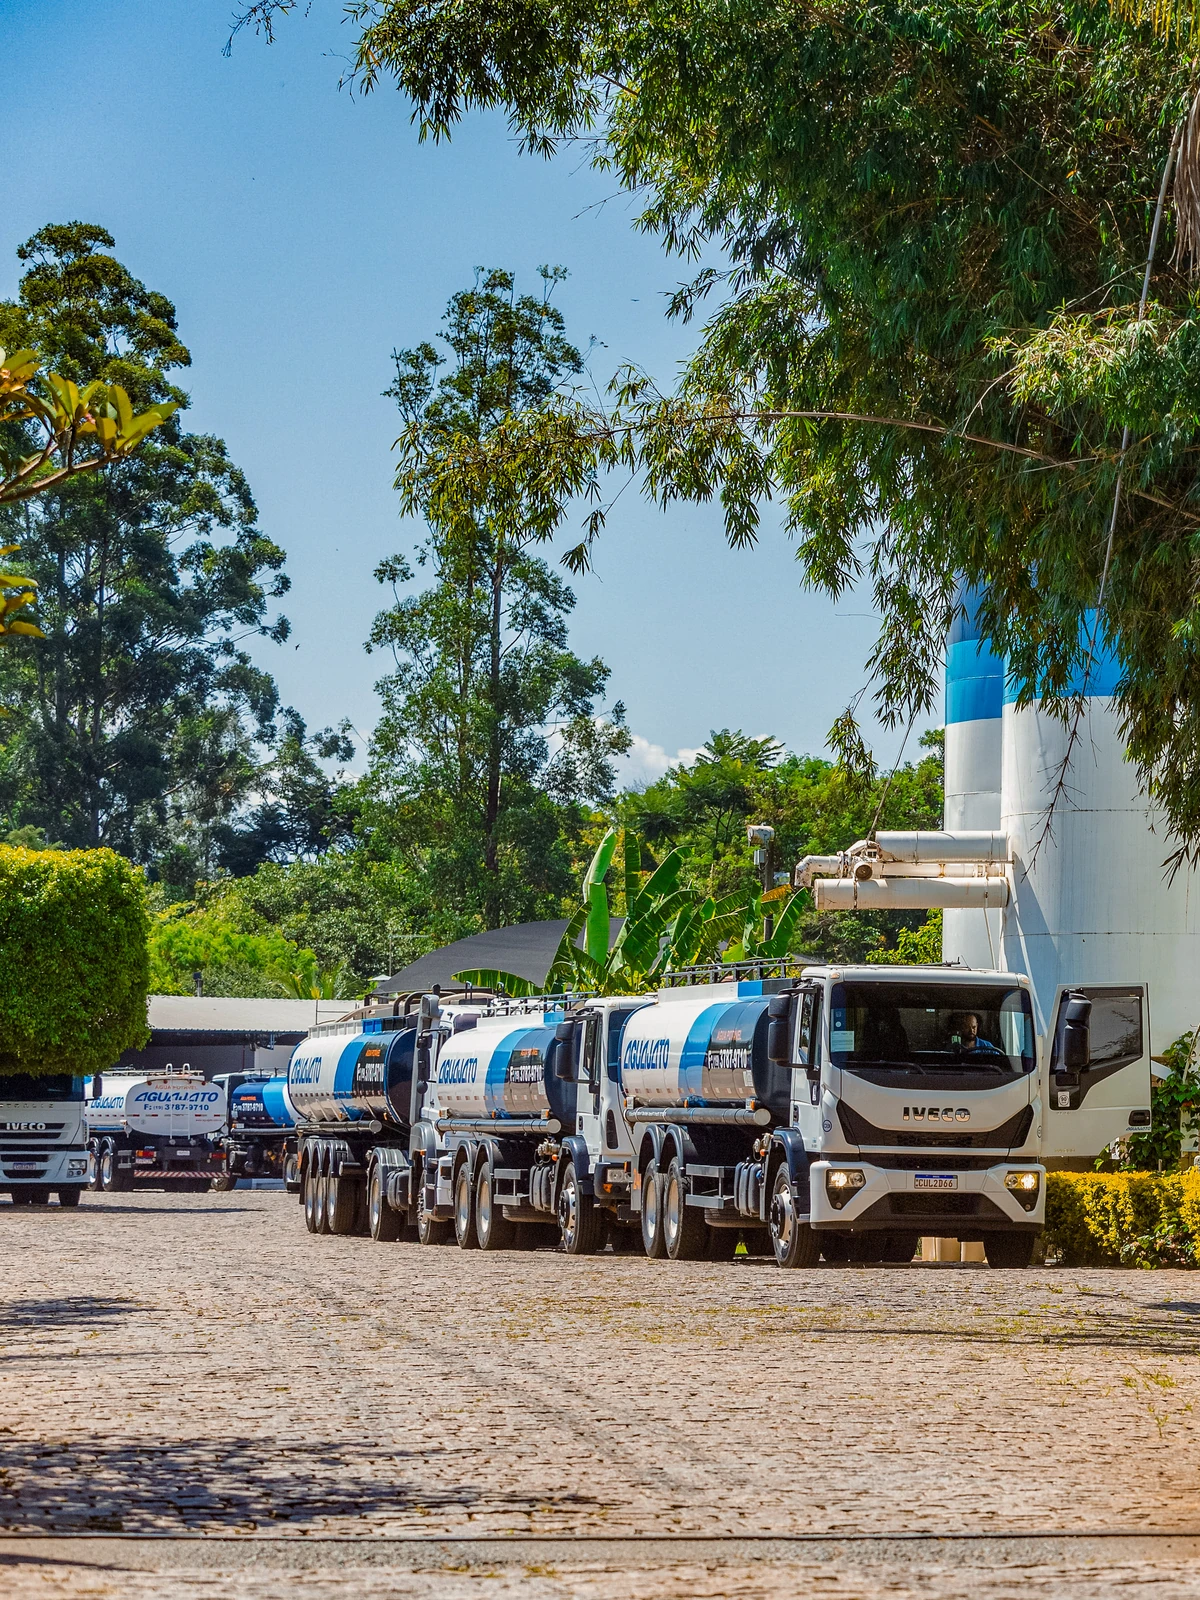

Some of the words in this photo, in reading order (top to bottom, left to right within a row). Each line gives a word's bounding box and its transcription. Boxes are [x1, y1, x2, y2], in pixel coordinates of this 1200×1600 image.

[624, 1039, 669, 1069] AGUAJATO
[720, 1049, 748, 1068] 3787-9710
[439, 1058, 477, 1084] AGUAJATO
[135, 1092, 218, 1102] AGUAJATO
[903, 1107, 971, 1122] IVECO
